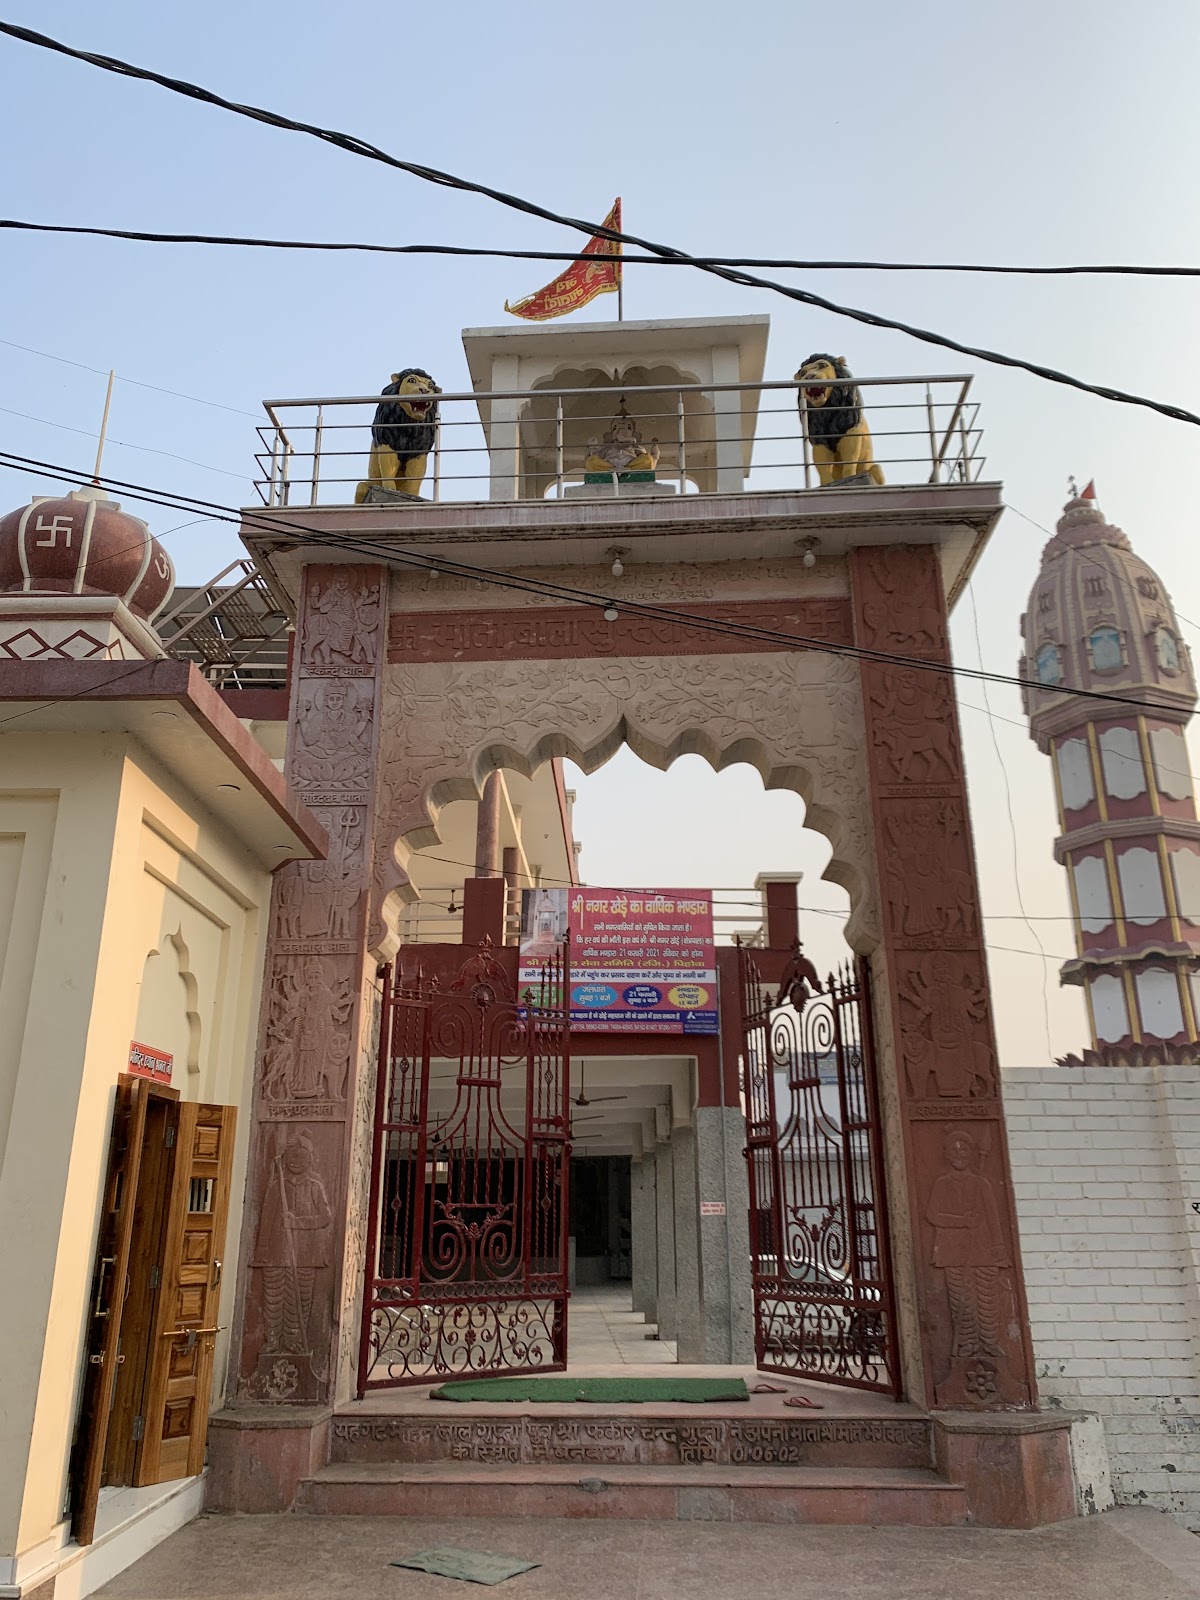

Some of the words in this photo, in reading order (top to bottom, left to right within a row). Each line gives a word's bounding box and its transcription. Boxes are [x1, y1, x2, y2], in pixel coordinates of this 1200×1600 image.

[586, 900, 609, 914] नगर
[630, 900, 643, 914] का
[646, 948, 660, 957] 2021
